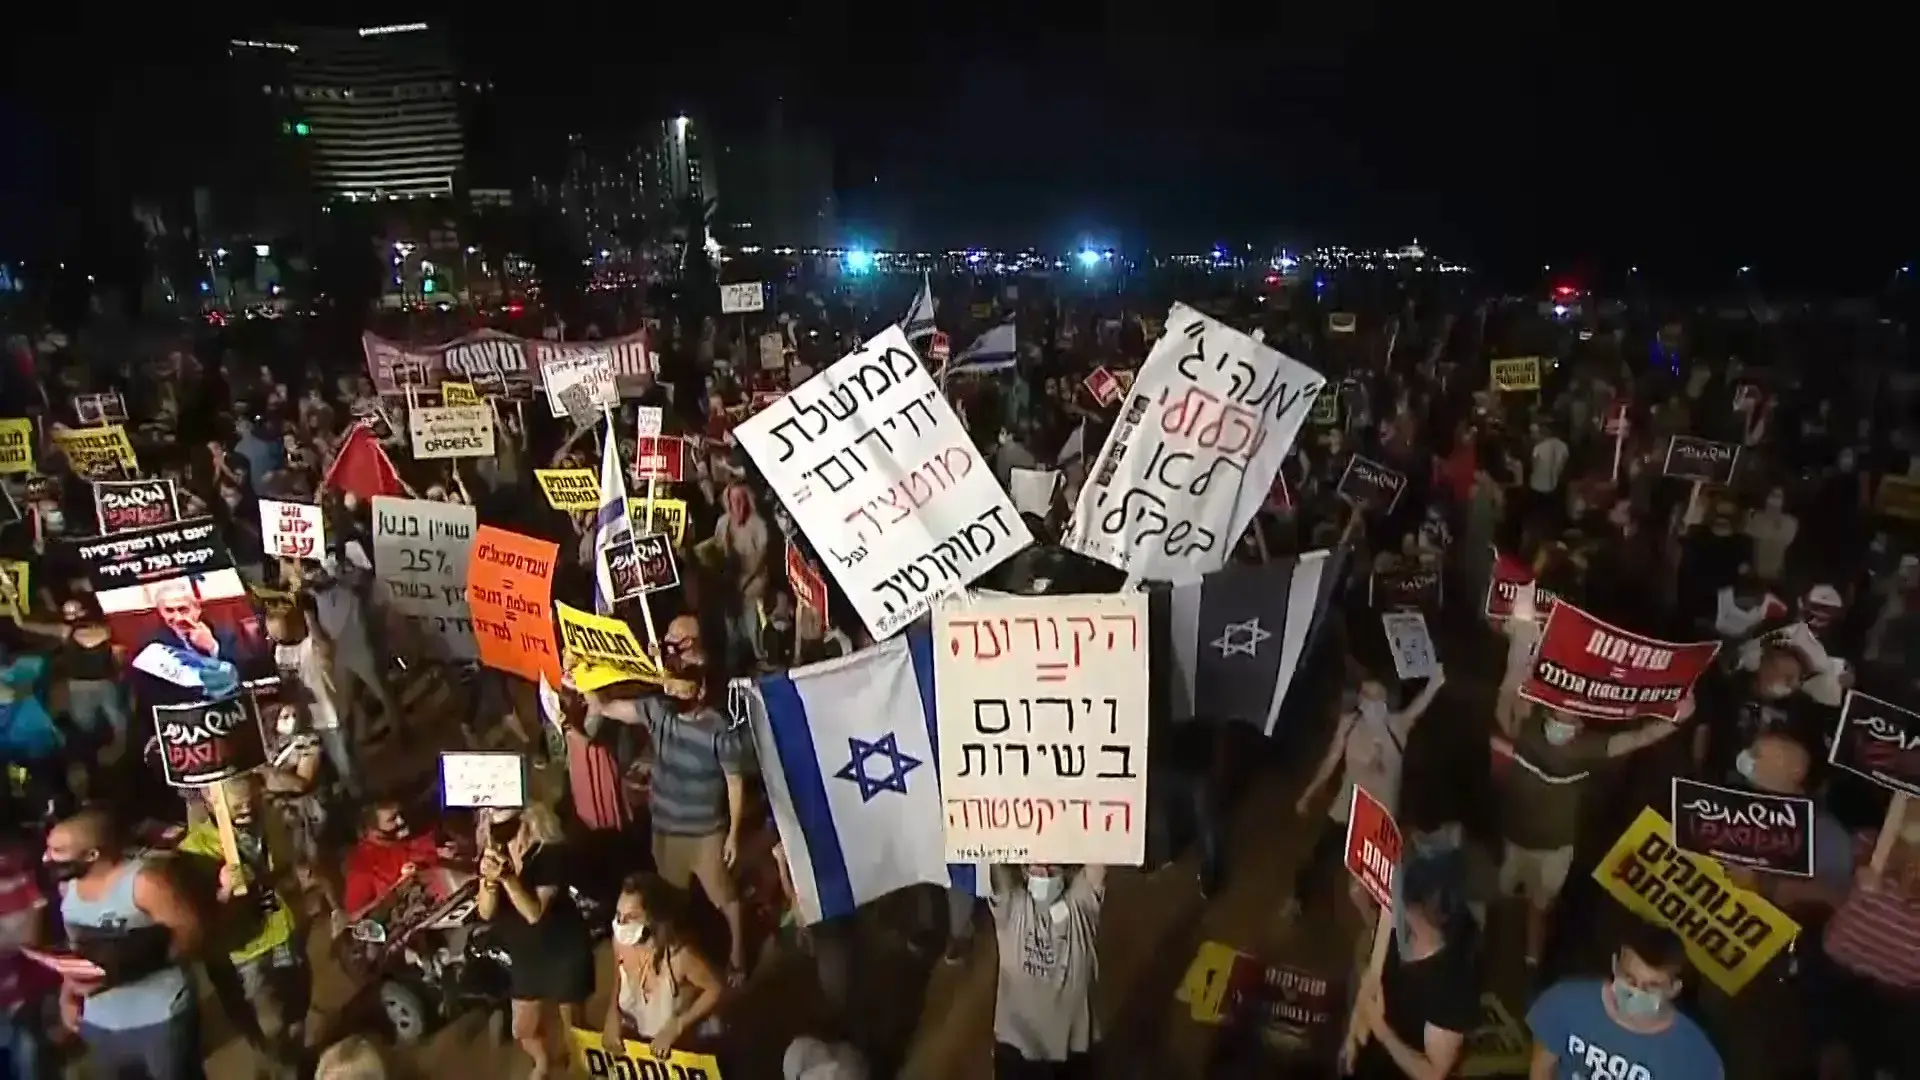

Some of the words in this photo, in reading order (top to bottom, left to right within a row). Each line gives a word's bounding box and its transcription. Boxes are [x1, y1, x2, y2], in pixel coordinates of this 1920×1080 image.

[769, 346, 919, 462] ממשלת
[424, 437, 483, 452] ORDERS
[1143, 441, 1244, 496] לא
[157, 531, 182, 549] אין
[1096, 487, 1216, 557] בשבילי
[80, 535, 155, 560] דמוקרטיה
[400, 547, 454, 573] 25%
[872, 505, 1011, 614] דמוקרטיה
[948, 613, 1137, 668] הקורונה
[1586, 628, 1674, 670] שחיתות
[957, 742, 1137, 779] בשירות
[947, 797, 1131, 835] הדיקטטורה
[1682, 799, 1797, 830] מושחתים
[1637, 832, 1773, 948] מנותקים
